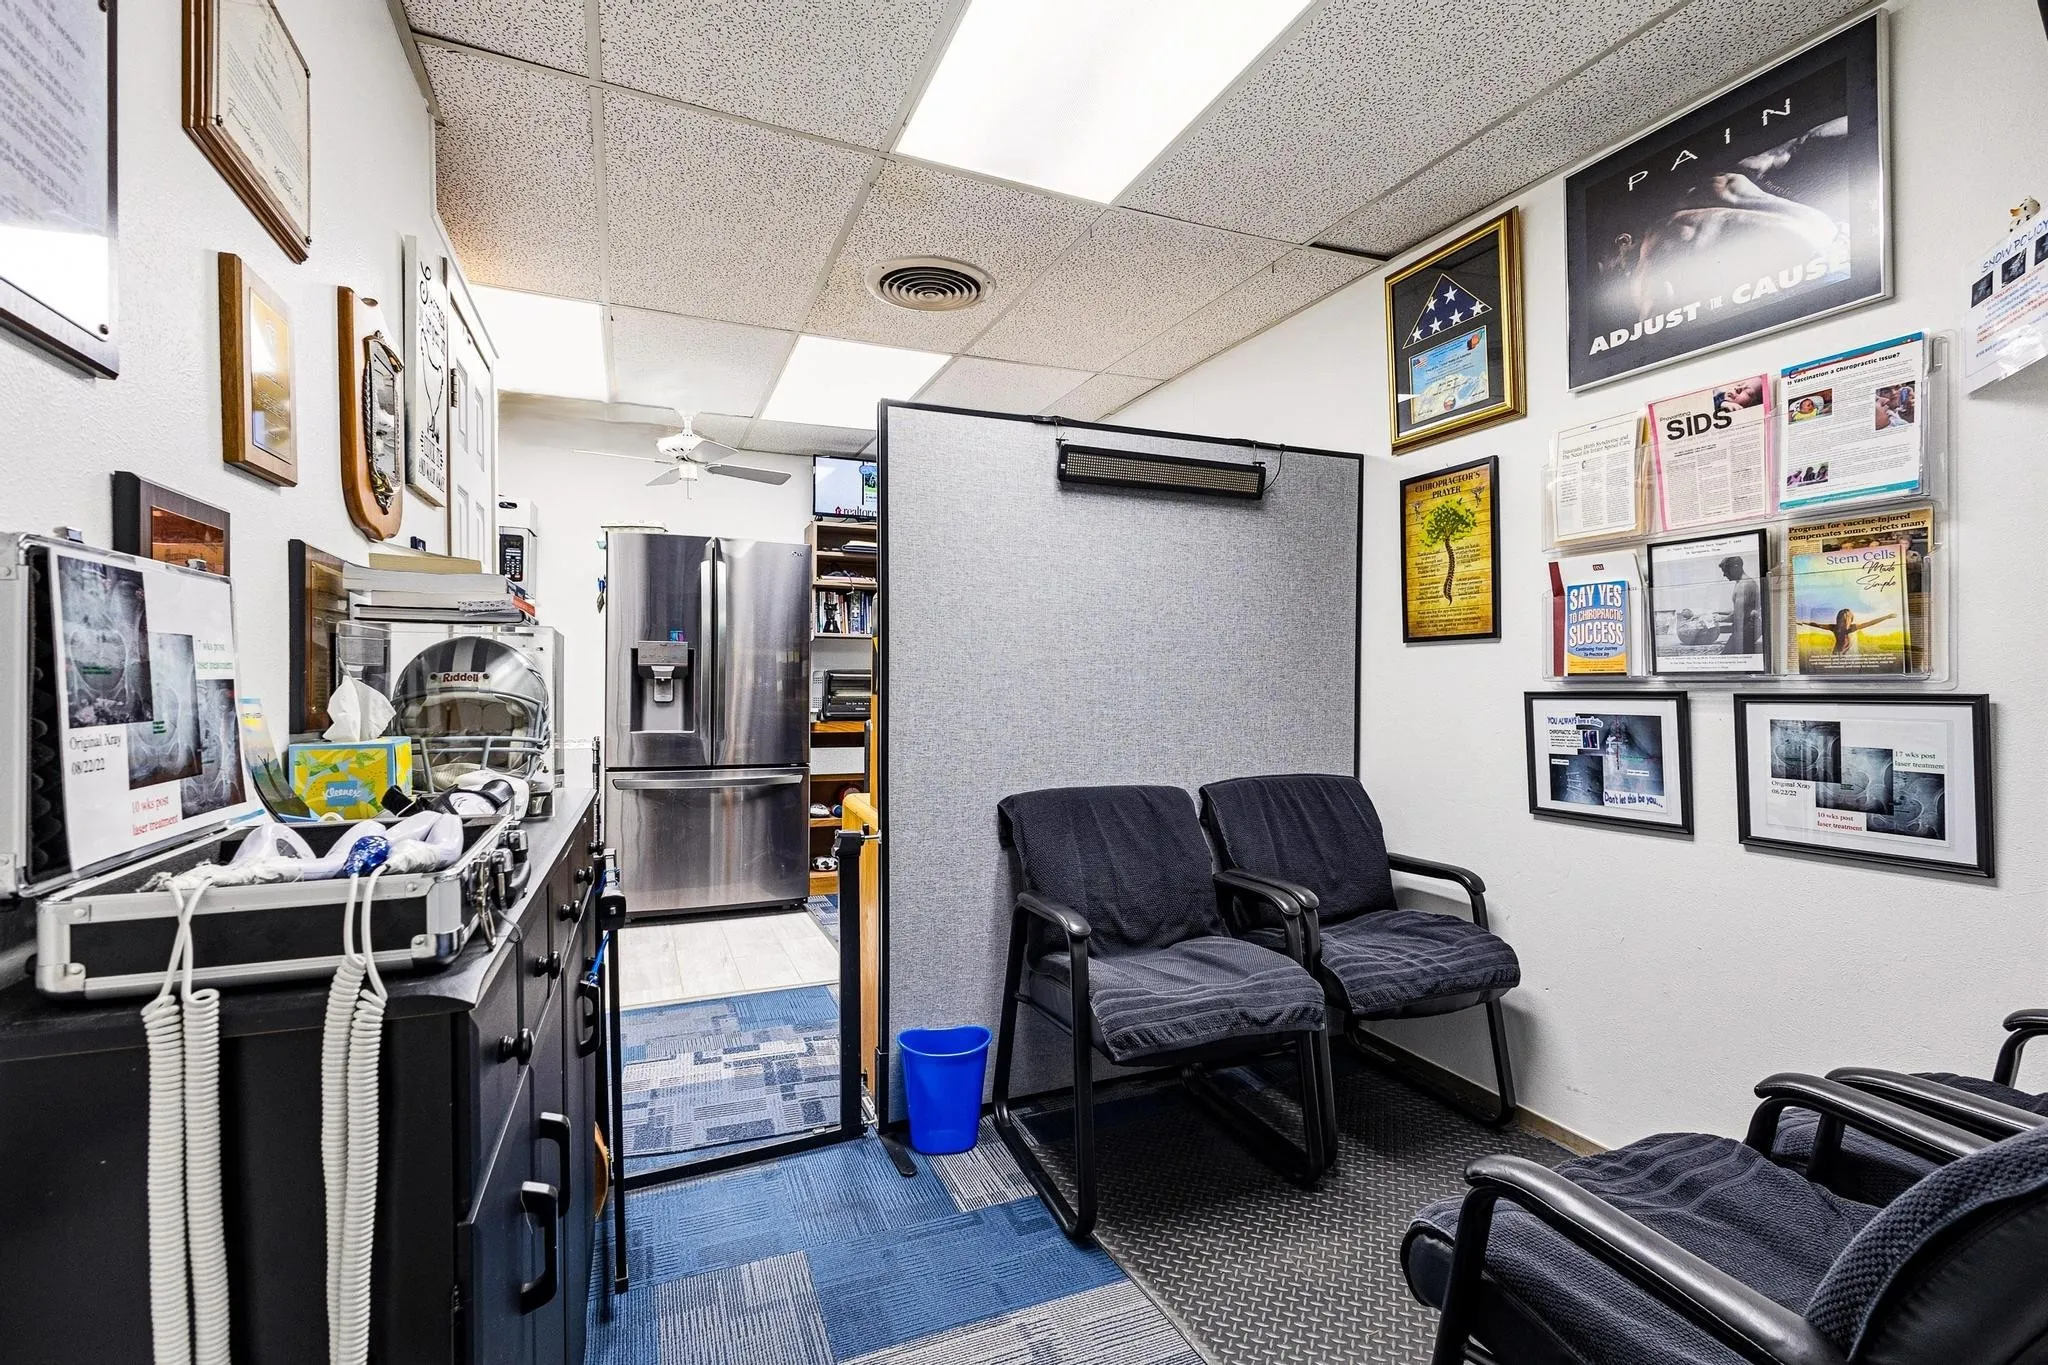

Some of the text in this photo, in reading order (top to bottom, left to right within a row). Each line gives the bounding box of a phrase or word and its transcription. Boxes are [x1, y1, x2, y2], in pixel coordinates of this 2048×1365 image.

[1627, 97, 1791, 192] PAIN
[1982, 220, 2048, 273] SNOW POLICY
[1588, 254, 1851, 356] ADJUST THE CAUSE
[1793, 370, 1829, 385] Vaccination
[1836, 358, 1877, 371] Chiropractic
[1666, 407, 1733, 441] SIDS
[1415, 471, 1480, 492] CHIROPRACTOR'S
[1432, 485, 1462, 499] PRAYER
[1788, 523, 1825, 535] Program
[1827, 521, 1841, 530] for
[1788, 519, 1927, 542] compensates some, rejects many
[1826, 549, 1896, 566] Stem Cells
[1856, 575, 1896, 592] Simple
[1569, 583, 1622, 611] SAY YES
[1569, 608, 1624, 624] TO CHIROPRACTIC
[1569, 621, 1624, 648] SUCCESS
[442, 672, 479, 682] Riddell
[1547, 716, 1557, 725] YOU
[1558, 716, 1577, 725] ALWAYS
[69, 733, 122, 752] Original Xray
[1904, 751, 1919, 759] wks
[1920, 753, 1936, 761] post
[71, 757, 105, 775] 08/22/22
[322, 787, 361, 800] Kleenex
[1771, 780, 1811, 791] Original Xray
[131, 796, 169, 813] 10 wks post
[1637, 793, 1645, 803] be
[131, 814, 179, 836] laser treatment
[1816, 811, 1854, 823] 10 wks post
[1816, 819, 1863, 831] laser treatment
